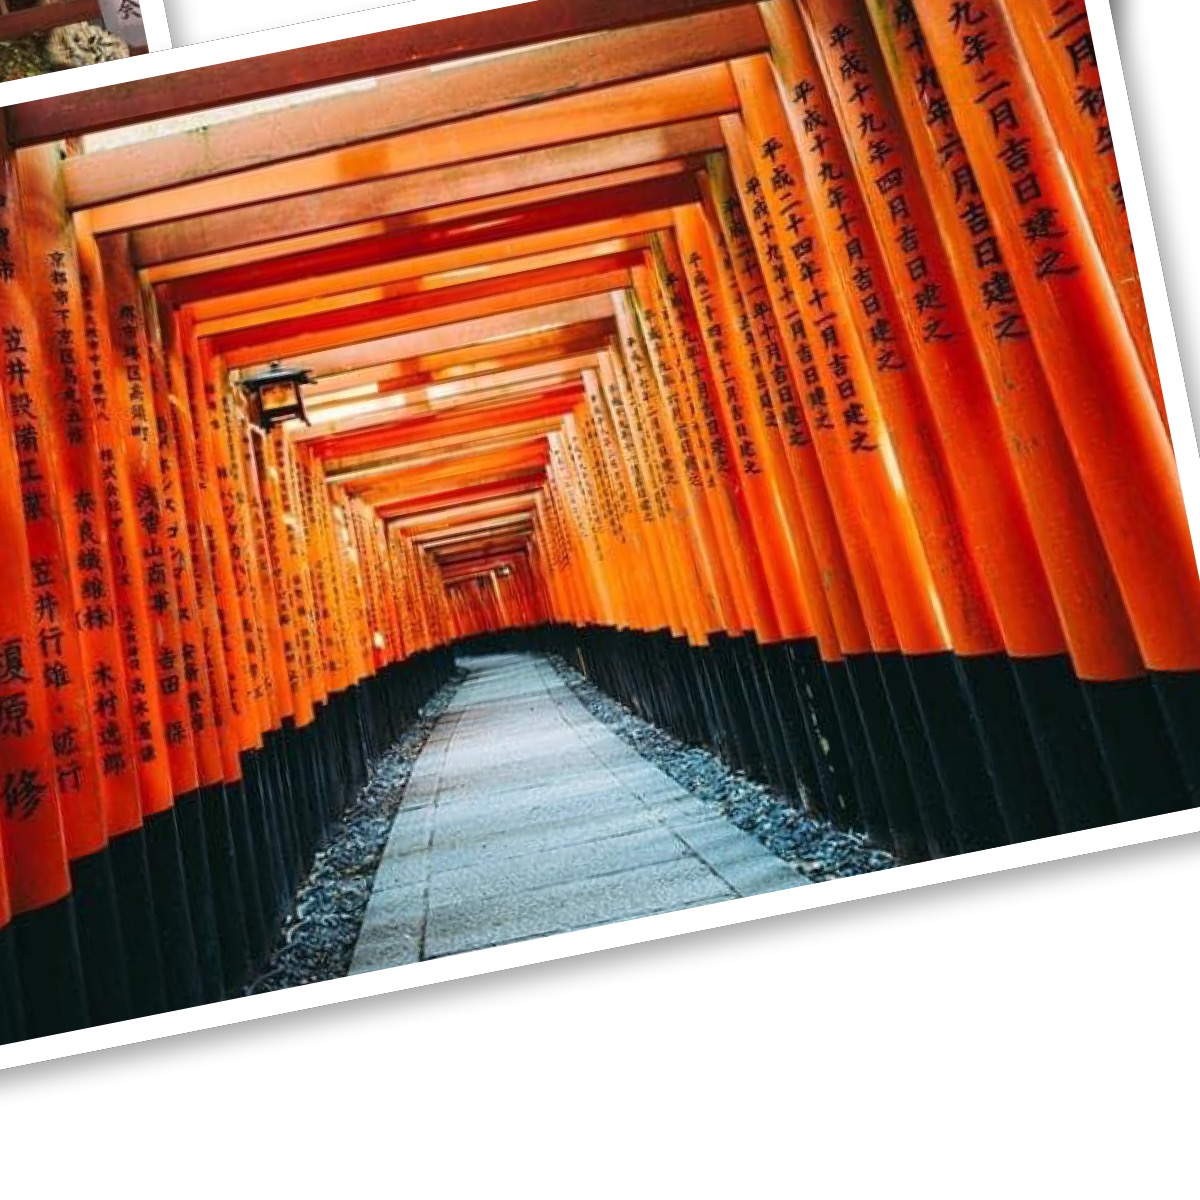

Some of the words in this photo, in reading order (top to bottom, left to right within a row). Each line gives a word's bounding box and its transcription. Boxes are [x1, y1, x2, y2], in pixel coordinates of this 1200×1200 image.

[793, 80, 905, 373] 平成十九年十月吉日建之
[829, 24, 953, 343] 平成十九年四月吉日建之
